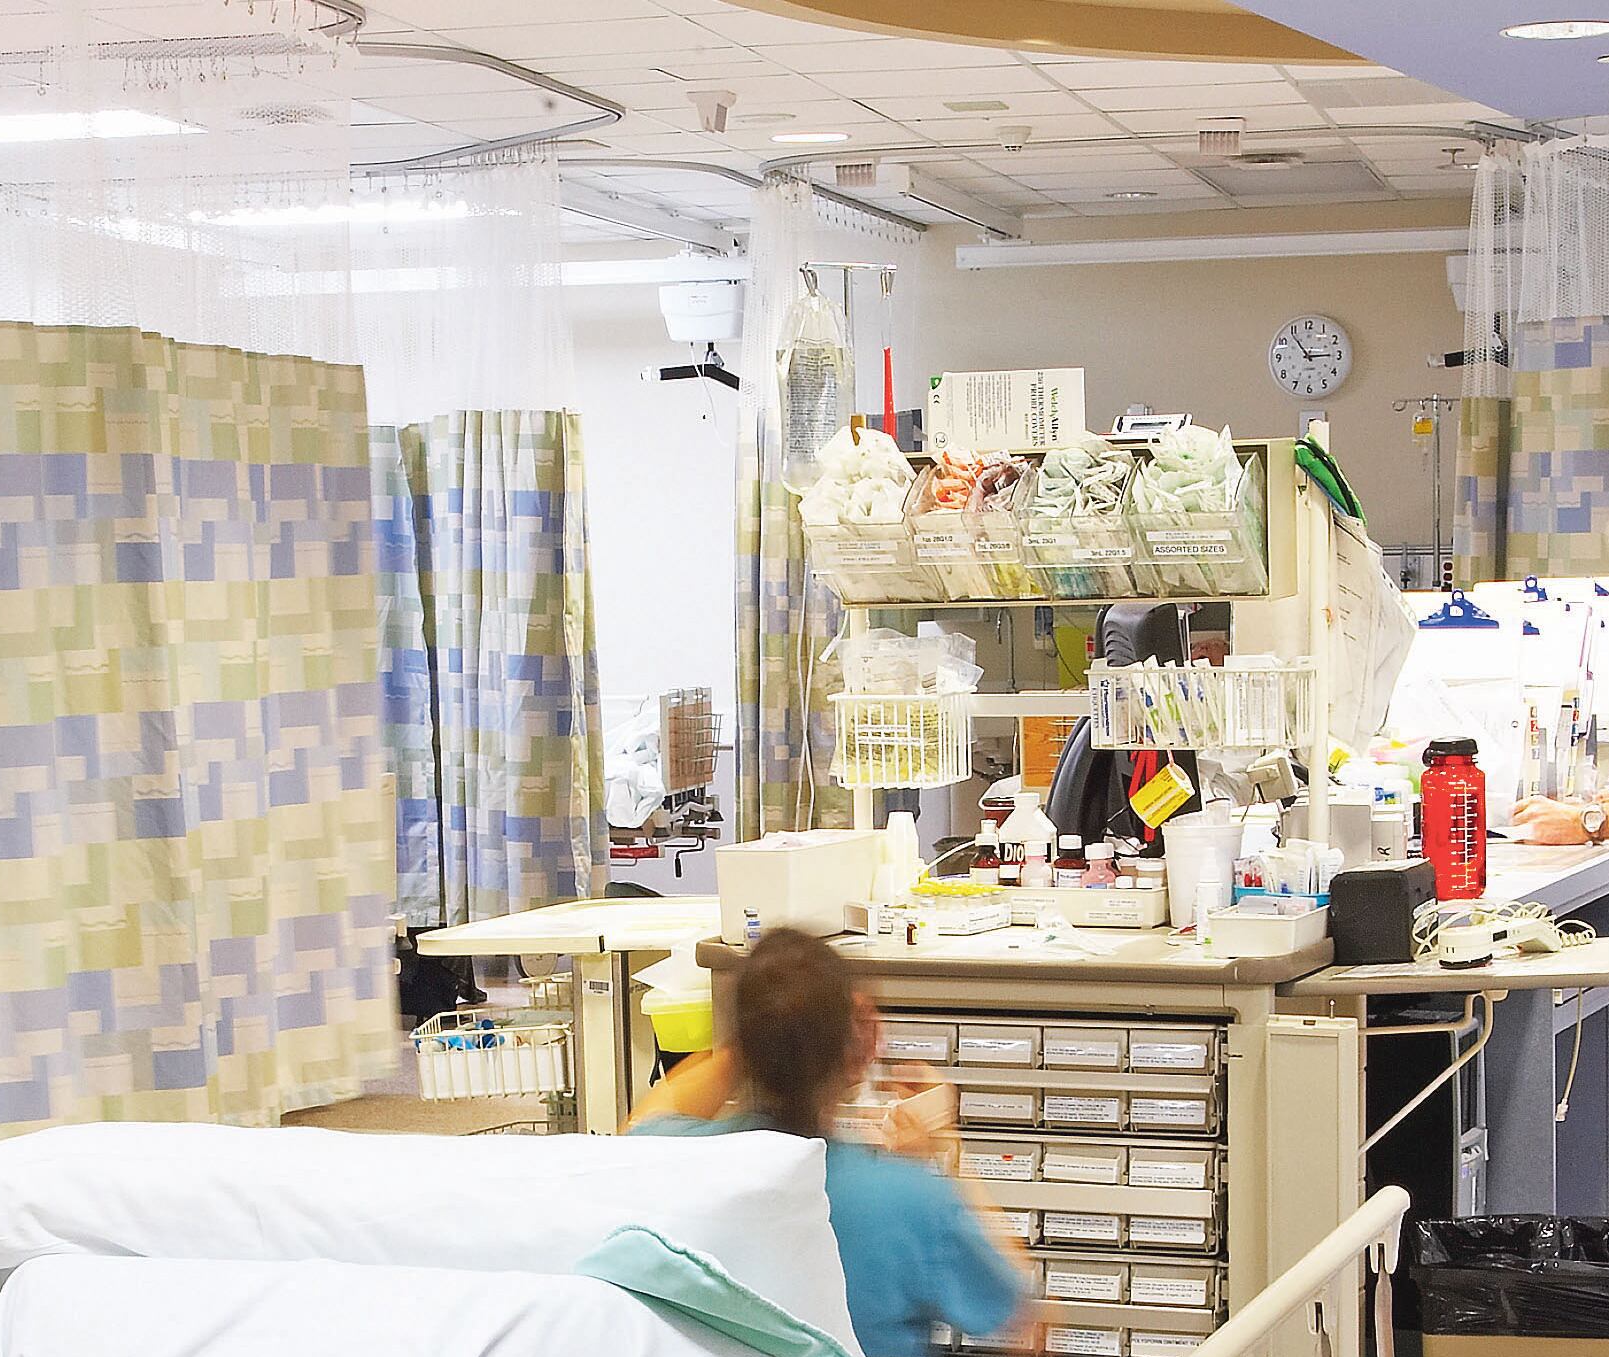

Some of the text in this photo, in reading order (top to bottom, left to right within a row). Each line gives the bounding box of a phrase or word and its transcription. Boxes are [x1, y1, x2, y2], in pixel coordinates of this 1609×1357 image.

[1290, 325, 1297, 335] 11
[1304, 320, 1314, 330] 12
[1322, 323, 1326, 334] 1
[1332, 335, 1339, 345] 2
[1275, 353, 1282, 363] 9
[1336, 350, 1343, 360] 3
[1280, 369, 1287, 379] 8
[1330, 367, 1337, 377] 4
[1292, 381, 1299, 391] 7
[1306, 384, 1313, 394] 6
[1321, 379, 1328, 389] 5
[1030, 384, 1039, 447] PROBE COVERS
[1155, 545, 1225, 553] ASSORTED SIZES
